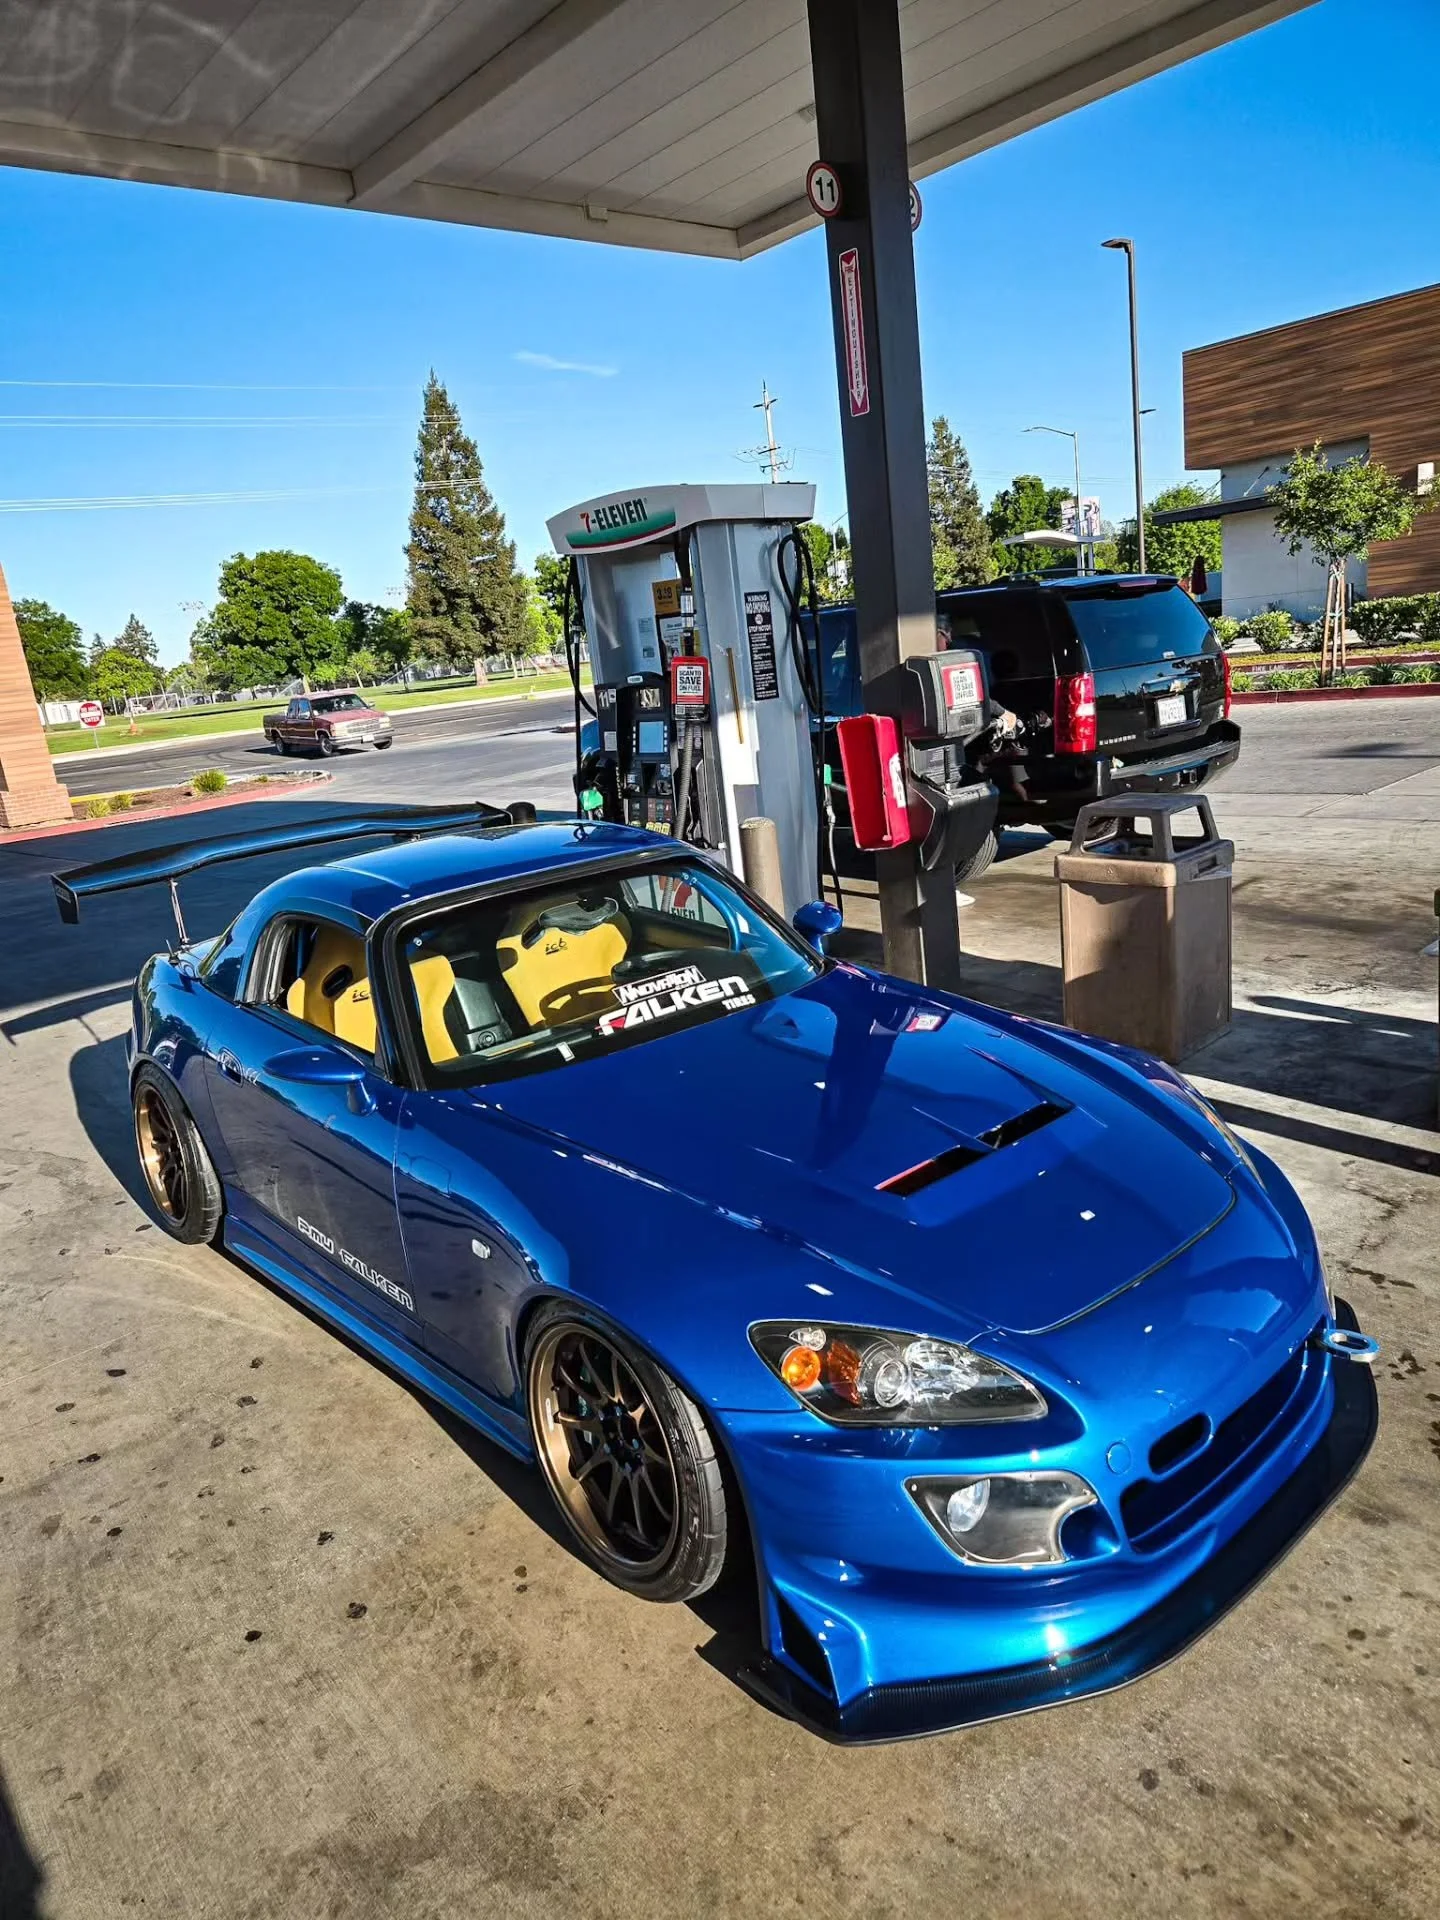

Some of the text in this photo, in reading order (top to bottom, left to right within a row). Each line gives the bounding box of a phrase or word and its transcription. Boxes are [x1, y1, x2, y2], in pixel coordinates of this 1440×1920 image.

[816, 177, 835, 202] 11
[679, 676, 702, 685] SAVE
[597, 976, 749, 1036] FALKEN
[339, 1249, 414, 1312] FALKEN
